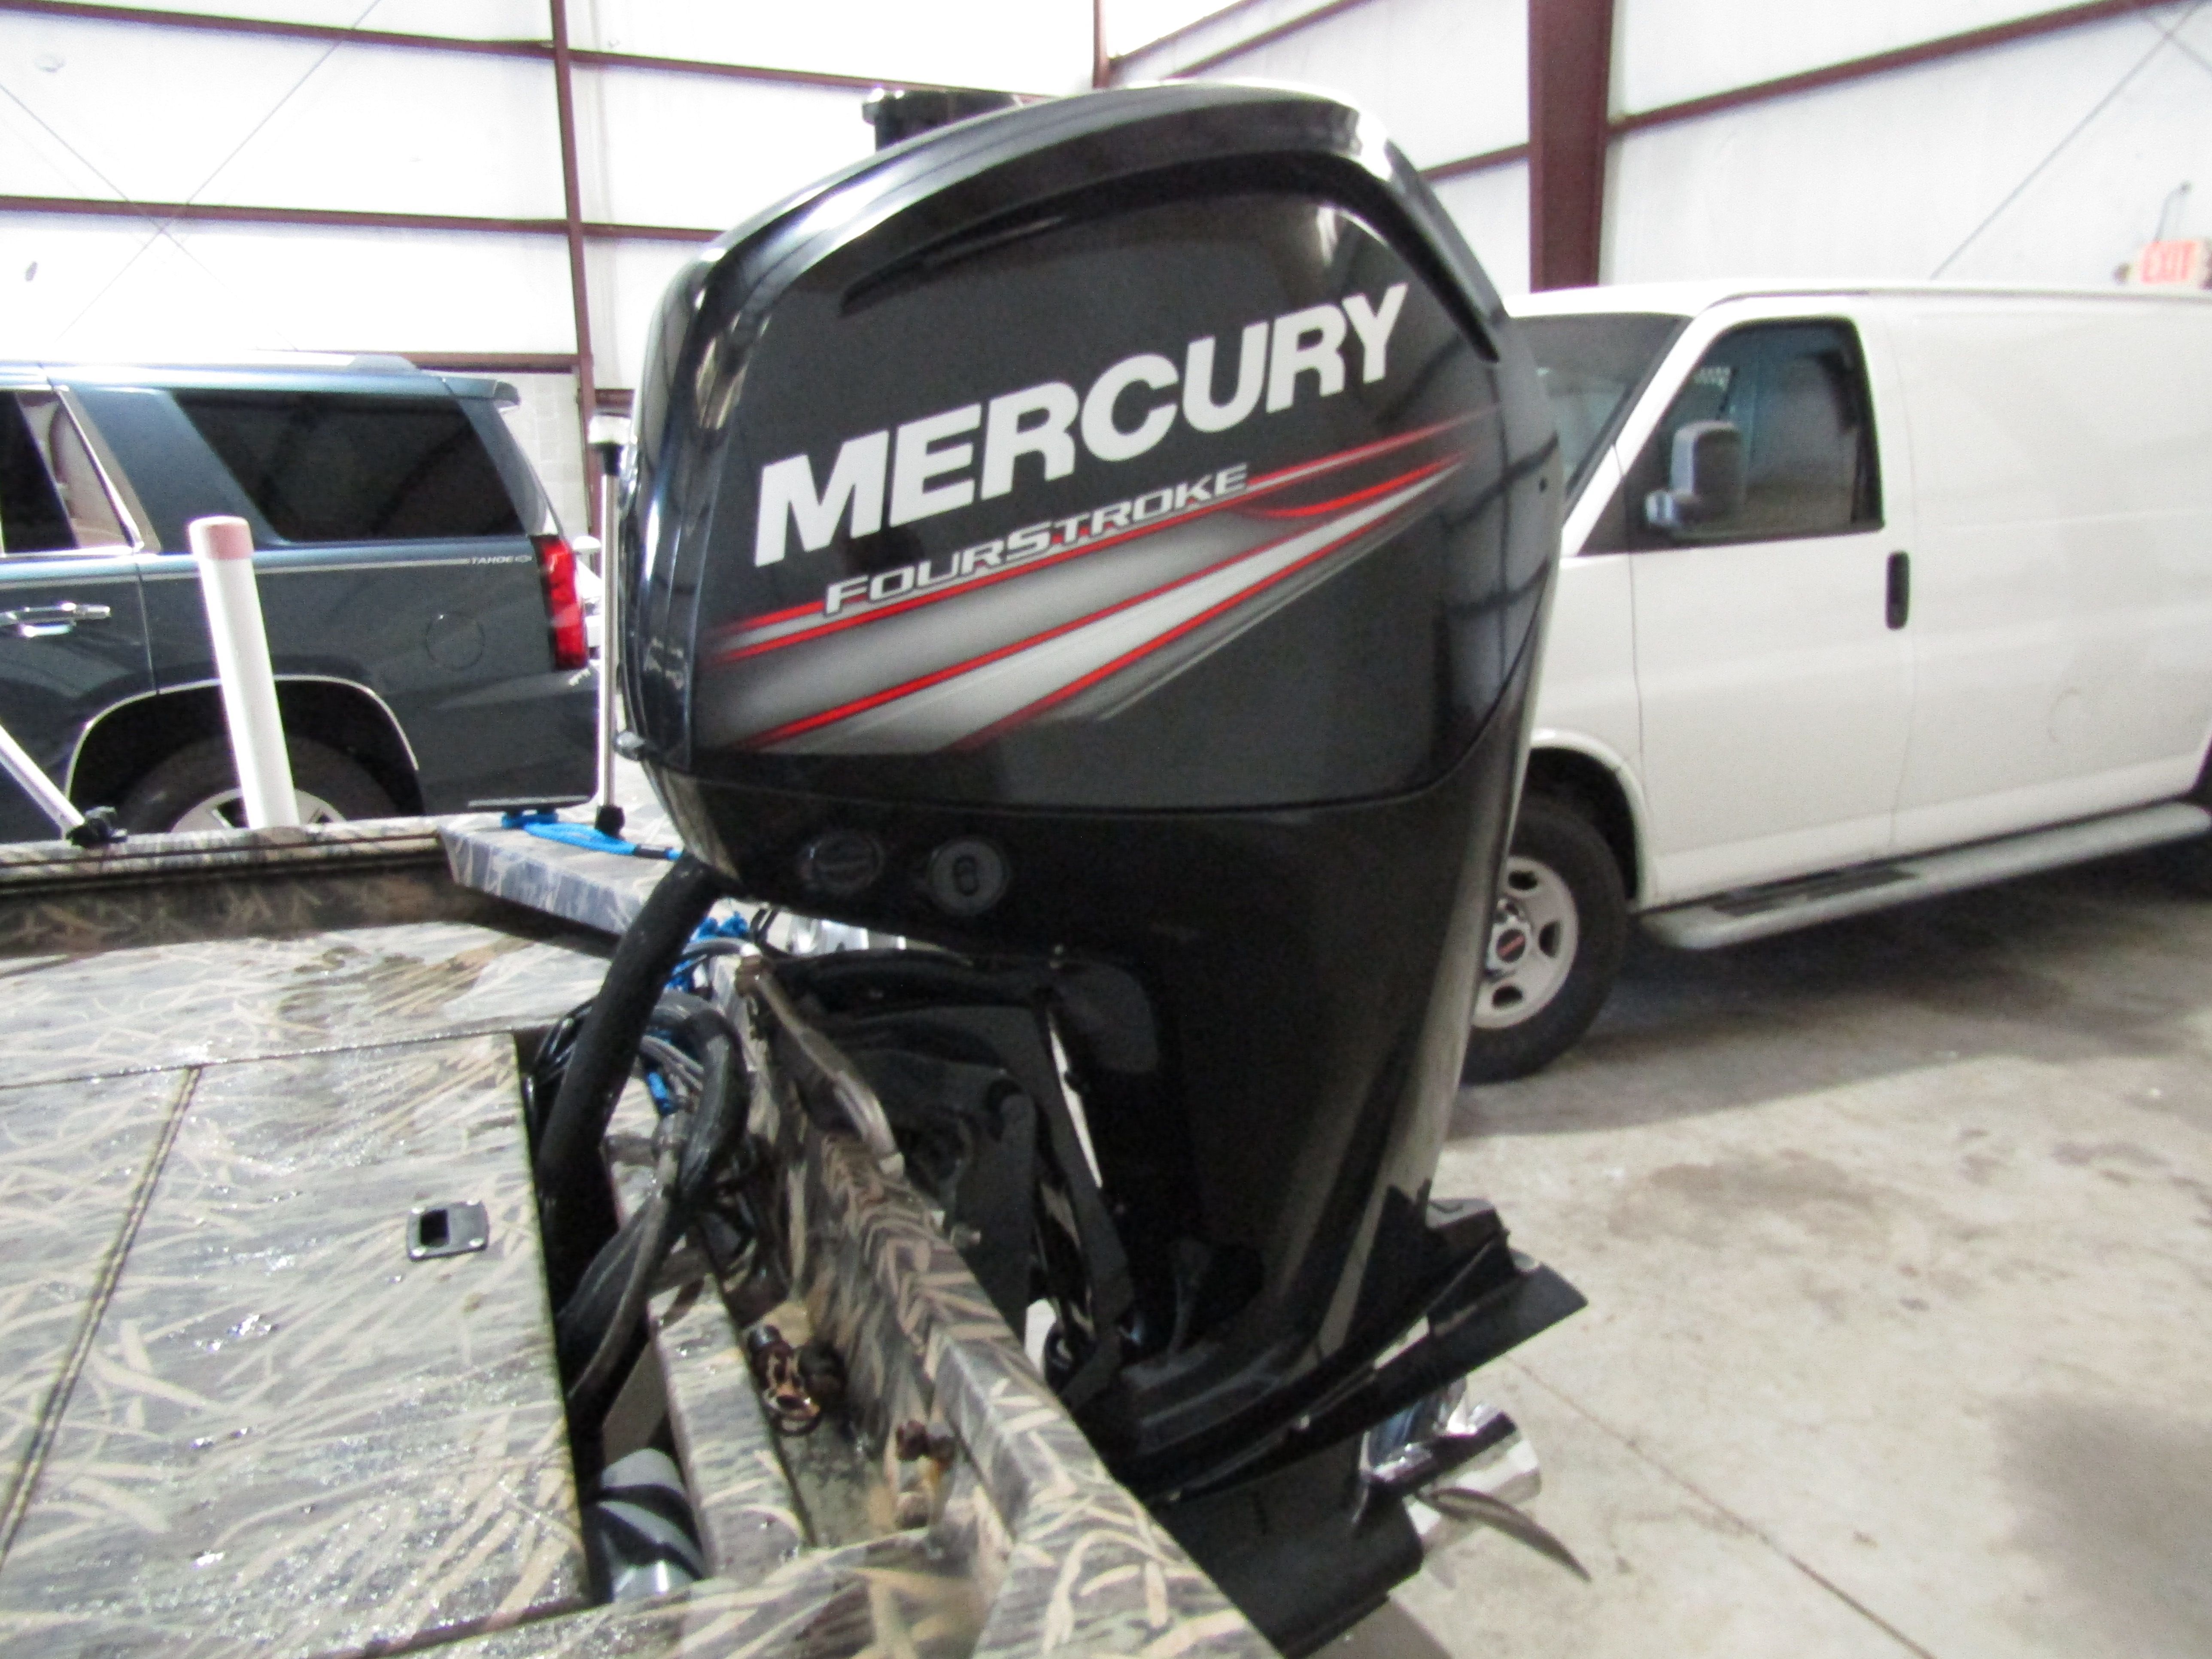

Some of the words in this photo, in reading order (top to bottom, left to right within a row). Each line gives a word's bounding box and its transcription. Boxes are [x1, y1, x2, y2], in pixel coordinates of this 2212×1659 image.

[754, 283, 1408, 567] MERCURY
[471, 556, 514, 565] TAHOE
[825, 463, 1248, 614] FOURSTROKE
